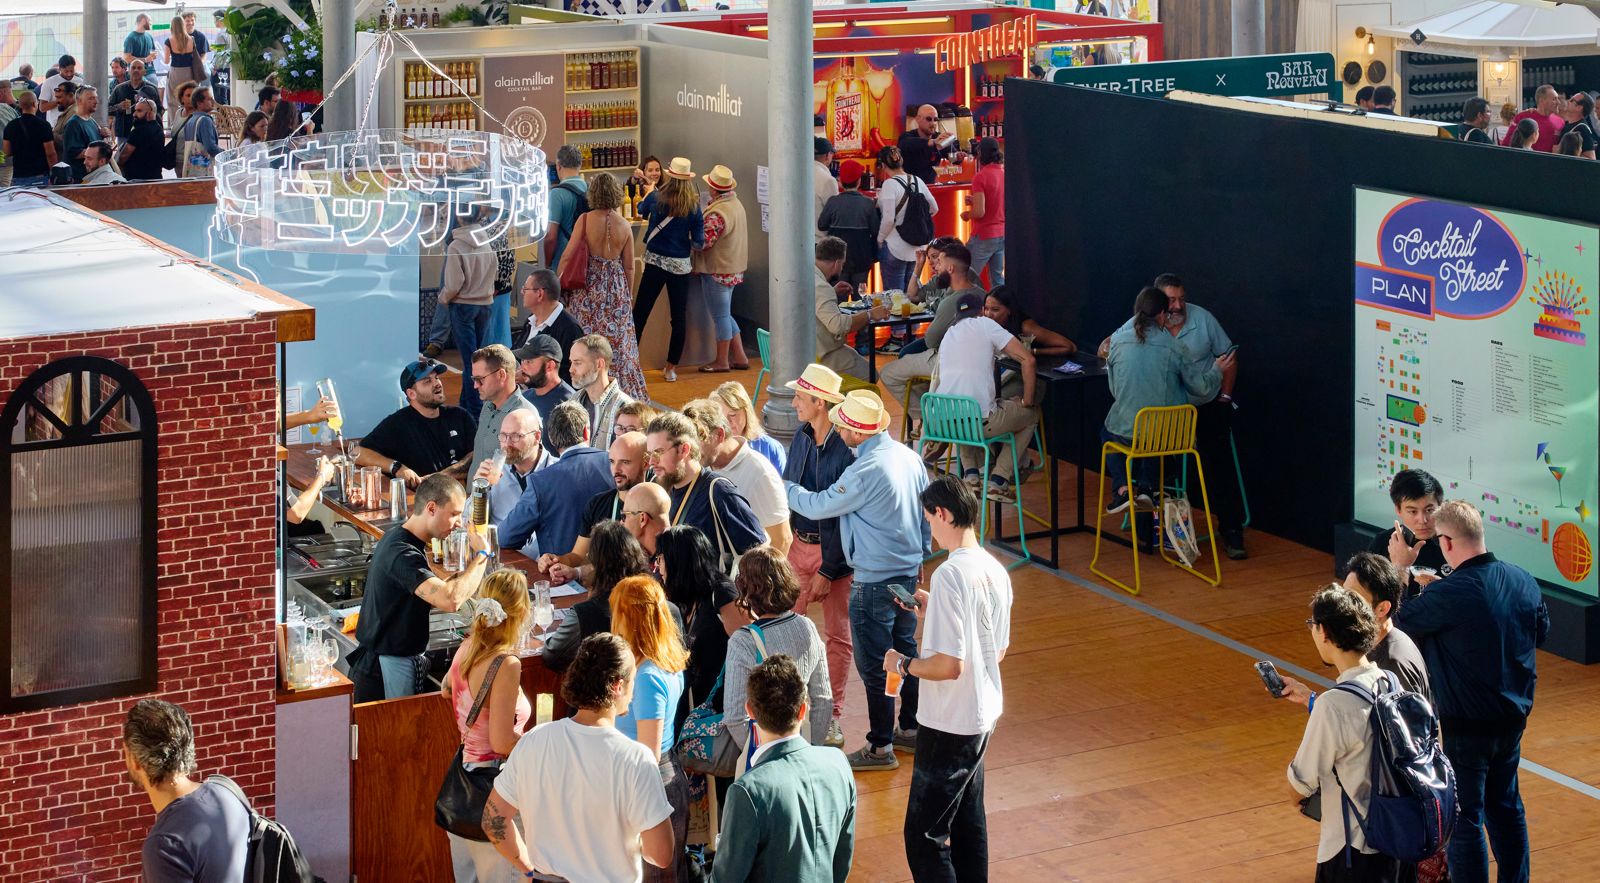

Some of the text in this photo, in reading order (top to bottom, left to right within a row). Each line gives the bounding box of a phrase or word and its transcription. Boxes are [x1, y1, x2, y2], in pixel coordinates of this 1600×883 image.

[935, 13, 1037, 74] COINTREAU
[494, 72, 554, 87] alain milliat
[1266, 69, 1328, 90] NOUVEAU
[1281, 61, 1313, 76] BAR
[1064, 78, 1176, 94] VER-TREE
[677, 83, 743, 117] alain milliat
[1393, 218, 1482, 265] Cocktail
[1372, 278, 1426, 305] PLAN
[1439, 258, 1509, 301] Street
